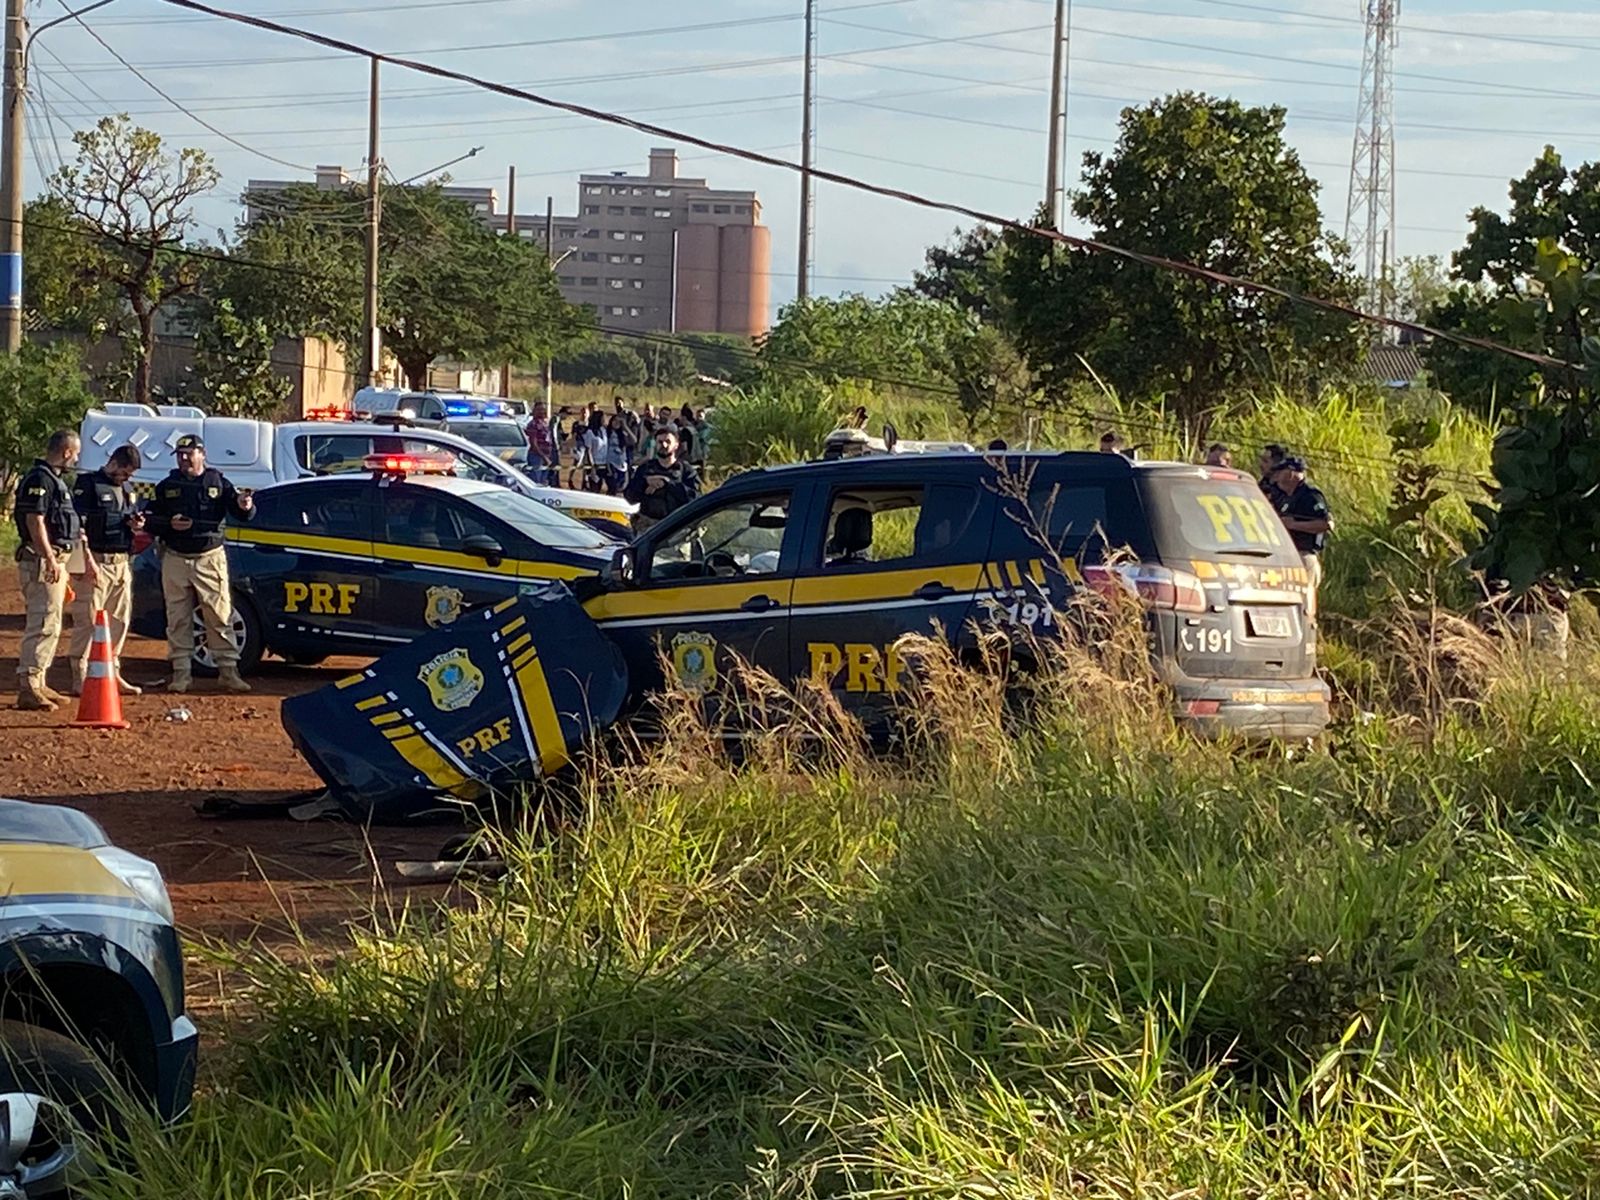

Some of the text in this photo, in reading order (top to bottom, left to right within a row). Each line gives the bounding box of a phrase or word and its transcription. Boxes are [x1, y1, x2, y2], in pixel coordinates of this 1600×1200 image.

[1195, 494, 1280, 546] PRF
[283, 582, 361, 615] PRF
[1007, 602, 1053, 627] 191
[1196, 628, 1232, 653] 191
[456, 717, 512, 758] PRF
